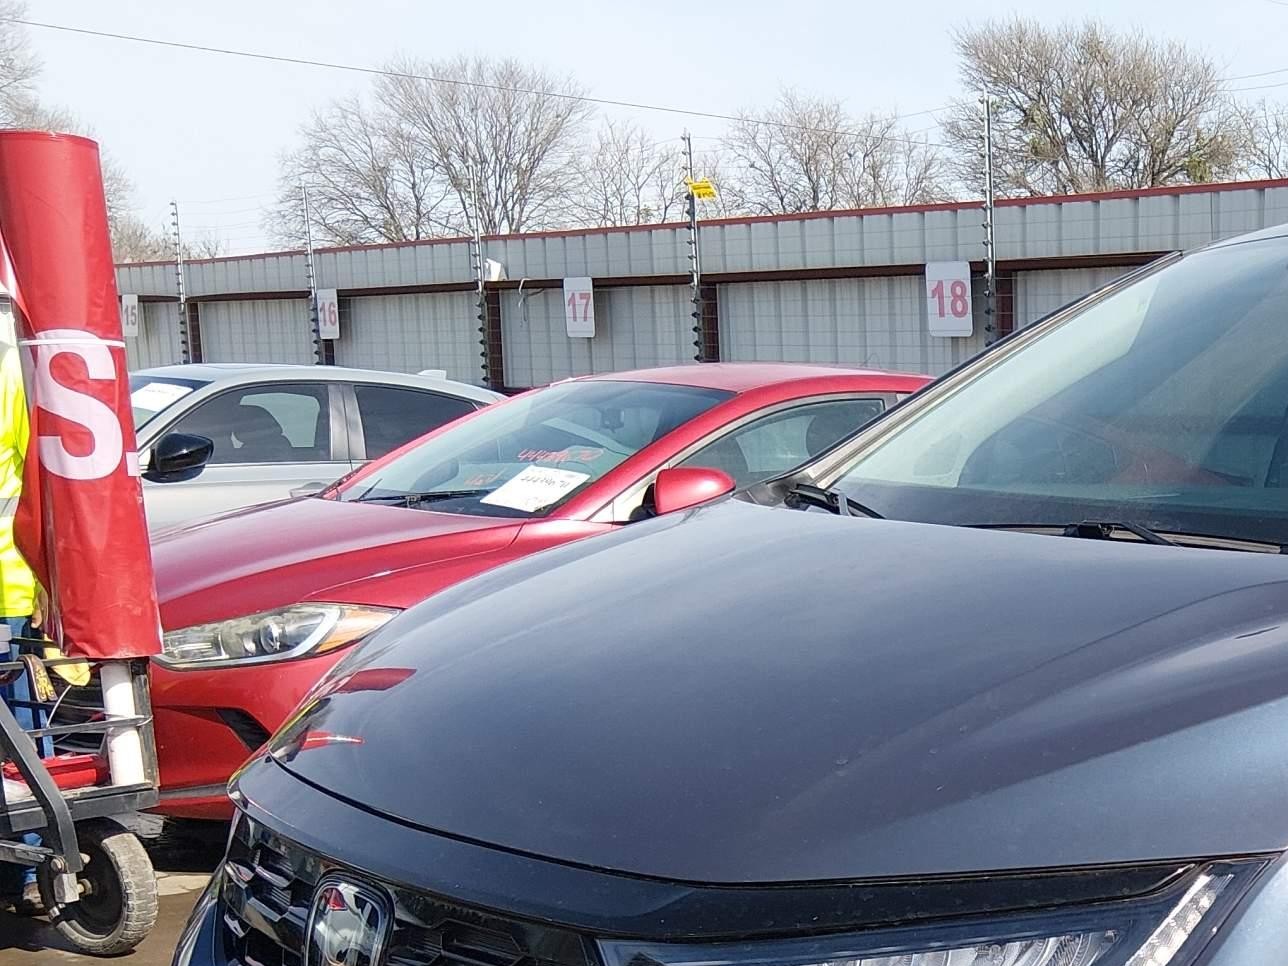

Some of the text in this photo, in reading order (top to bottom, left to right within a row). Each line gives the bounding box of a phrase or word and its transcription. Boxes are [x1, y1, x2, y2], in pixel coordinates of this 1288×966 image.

[567, 291, 592, 322] 17
[930, 279, 968, 319] 18
[124, 304, 138, 326] 15
[320, 301, 337, 327] 16
